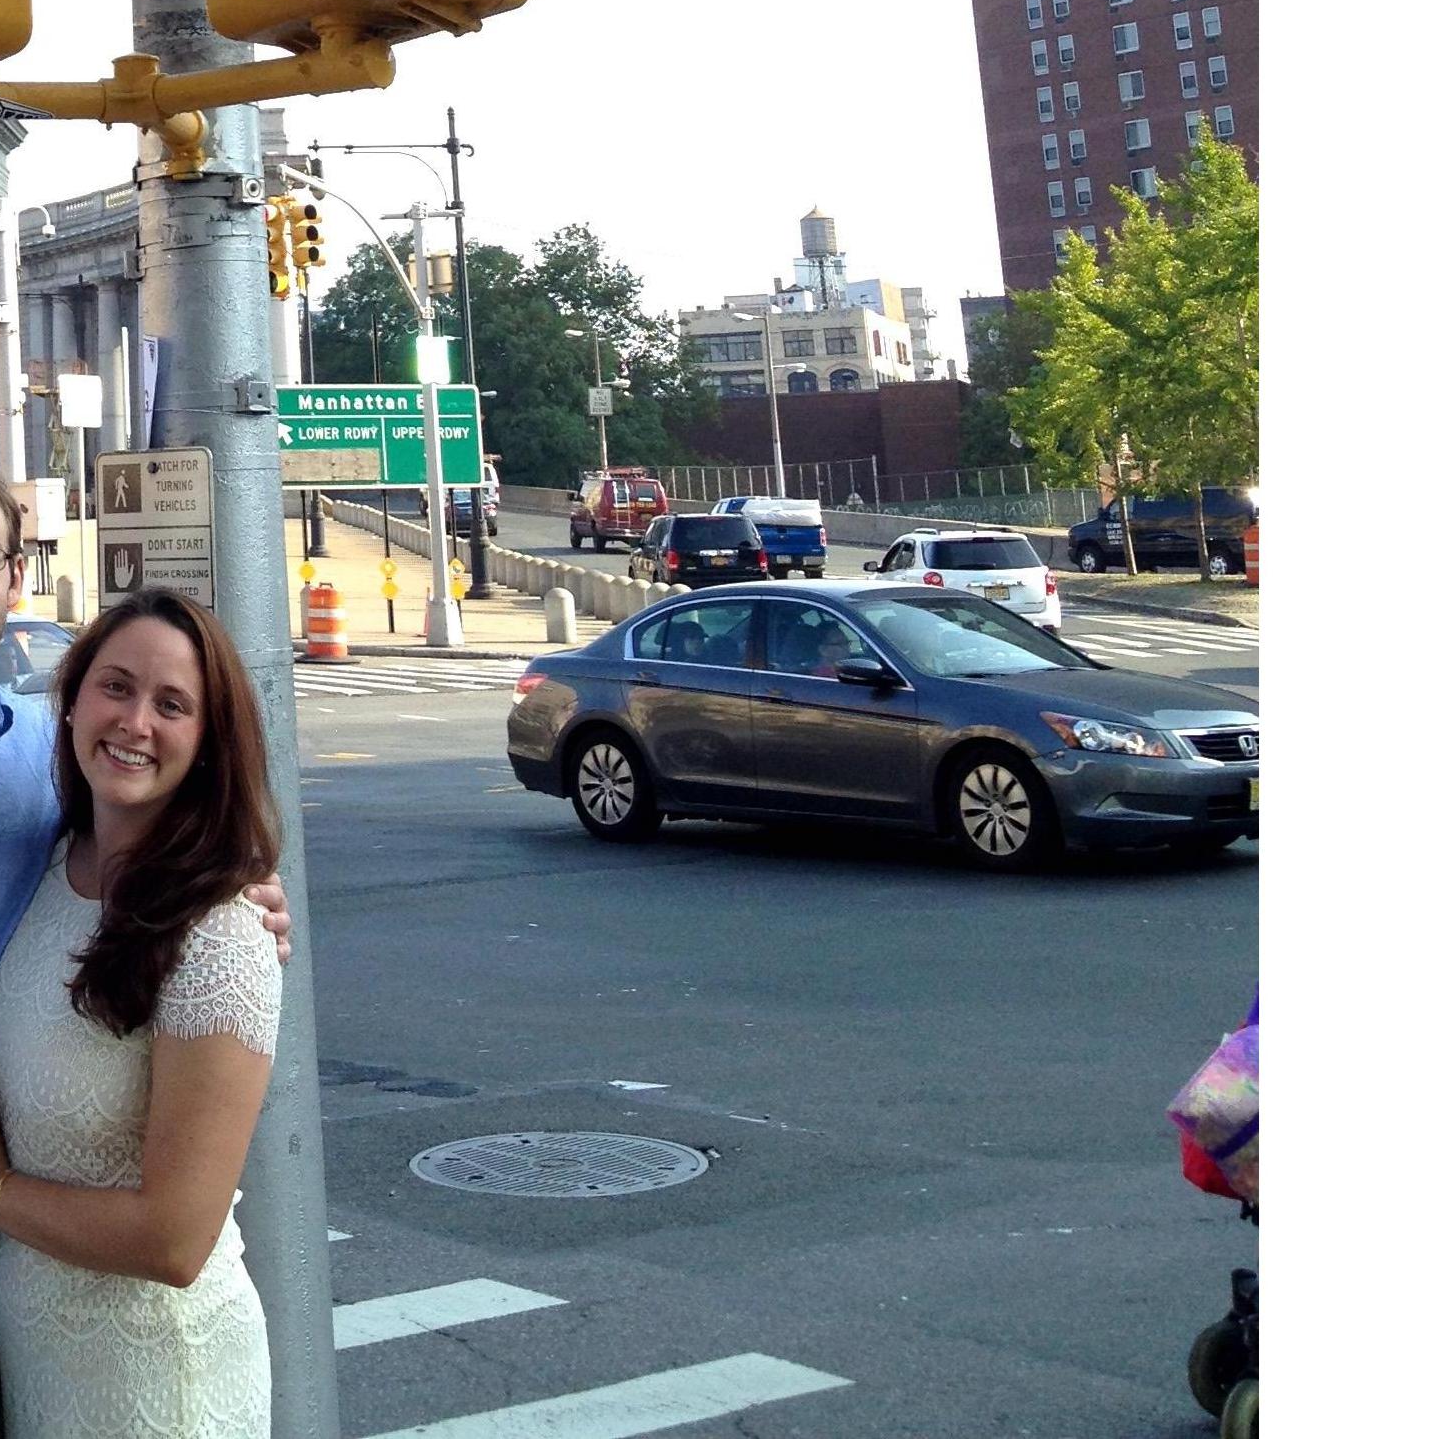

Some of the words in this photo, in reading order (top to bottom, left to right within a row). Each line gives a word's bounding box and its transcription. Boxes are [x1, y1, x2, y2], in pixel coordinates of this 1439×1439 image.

[298, 394, 408, 410] Manhattan
[298, 427, 340, 440] LOWER
[344, 426, 379, 440] RDWY
[392, 426, 425, 439] UPPE
[155, 460, 180, 472] ATCH
[181, 459, 199, 471] FOR
[156, 480, 193, 492] TURNING
[154, 499, 197, 512] VEHICLES
[148, 539, 174, 551] DON'T
[176, 538, 204, 550] START
[171, 569, 209, 579] CROSSING
